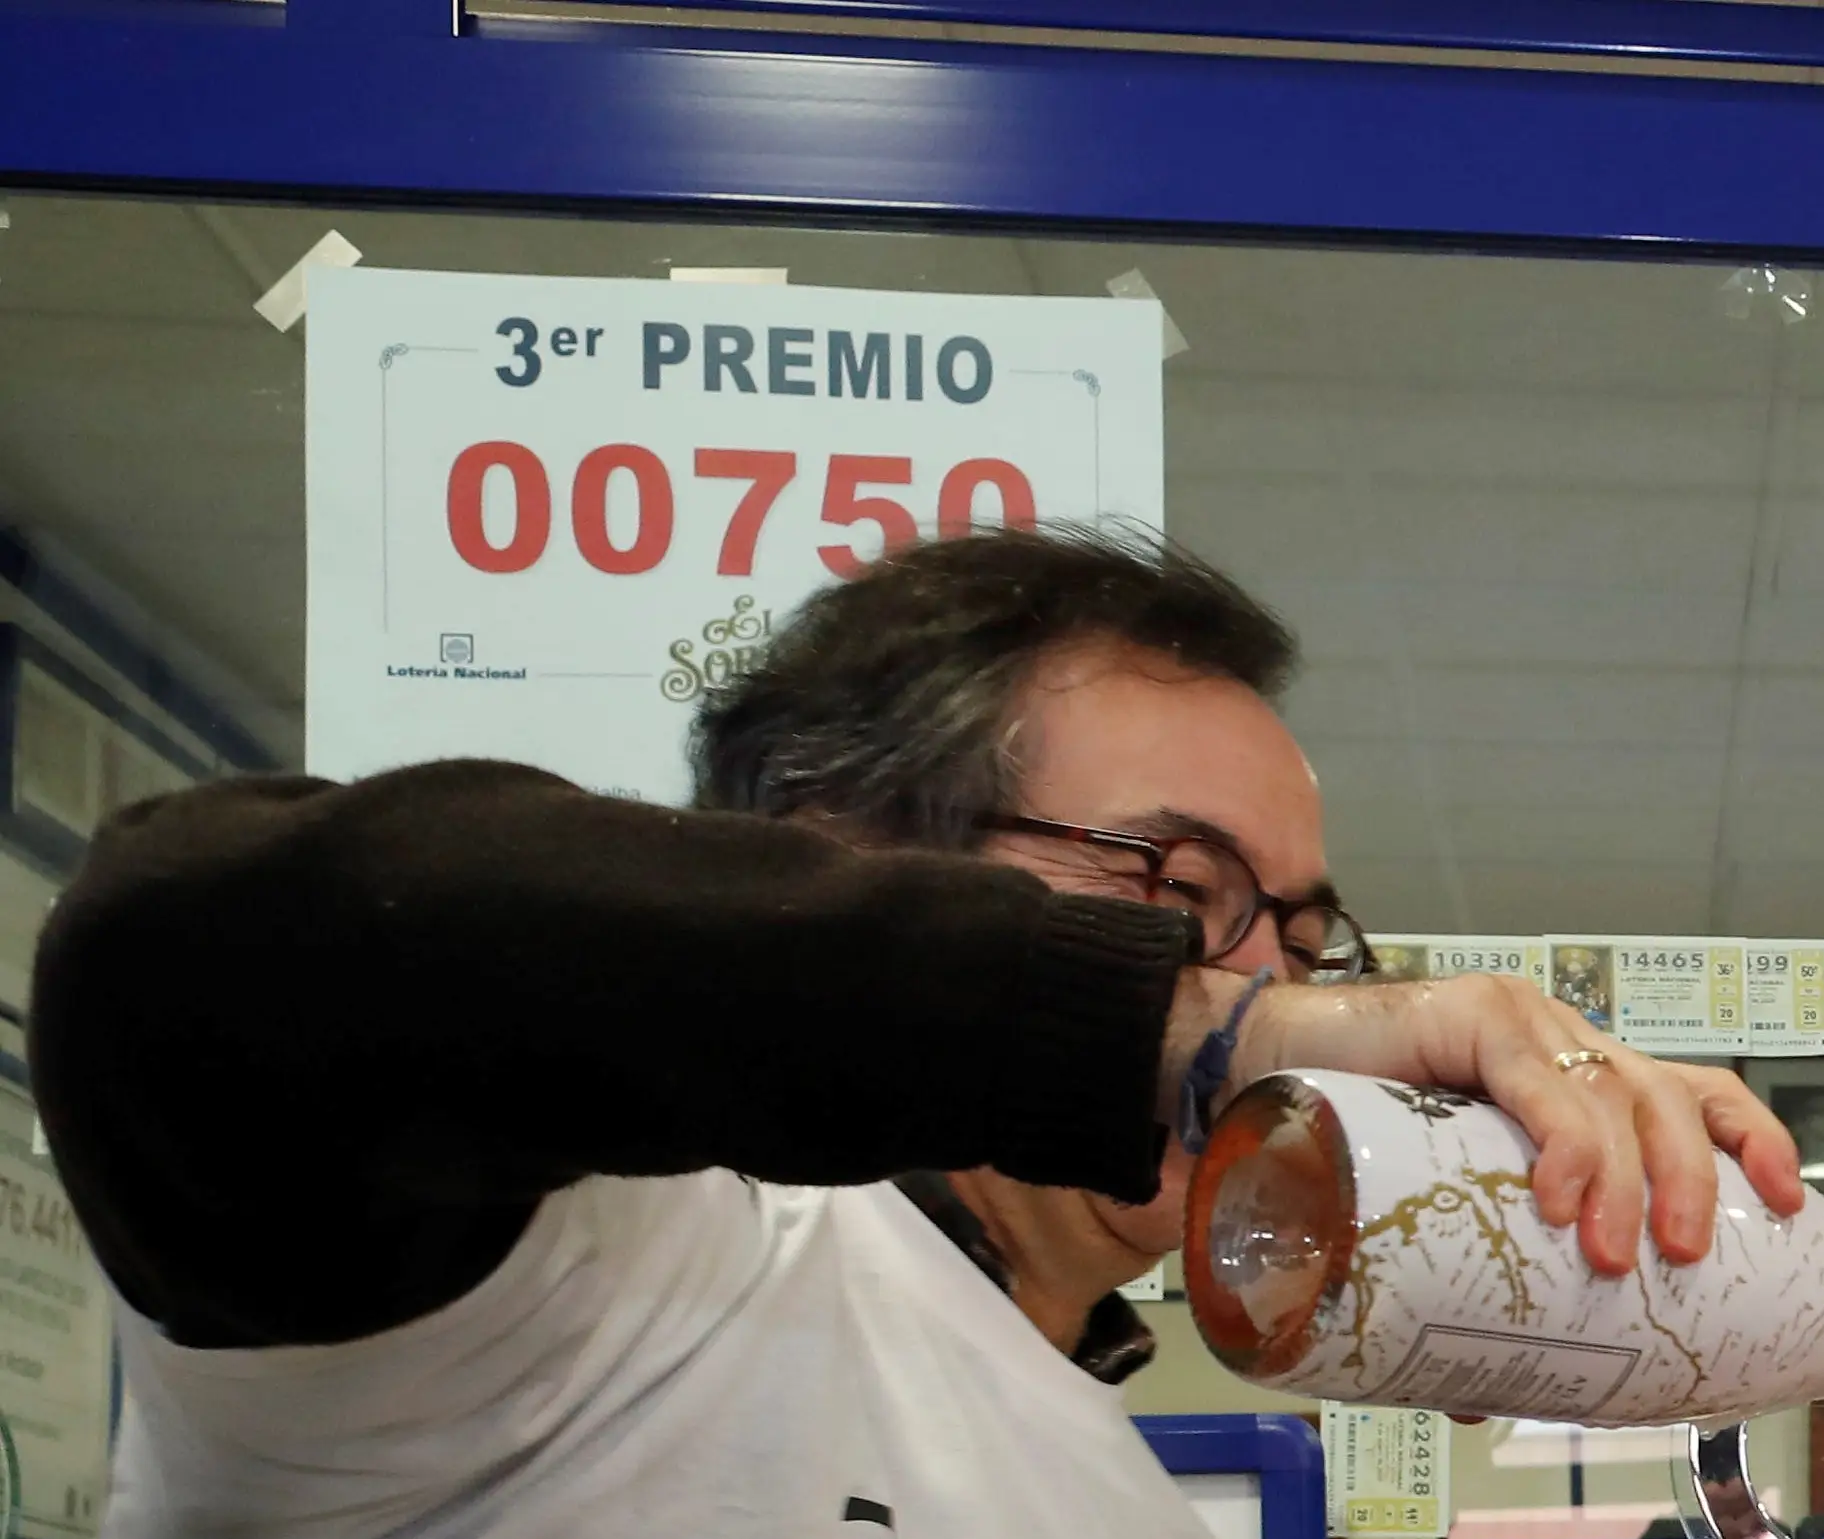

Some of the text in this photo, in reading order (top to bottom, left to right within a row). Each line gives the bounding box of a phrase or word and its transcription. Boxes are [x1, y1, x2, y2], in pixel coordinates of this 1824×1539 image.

[494, 315, 995, 405] 3er PREMIO
[445, 439, 1038, 580] 00750
[454, 666, 527, 680] Nacional
[1434, 952, 1522, 970] 10330
[1621, 952, 1704, 968] 14465
[1413, 1410, 1431, 1496] 62428
